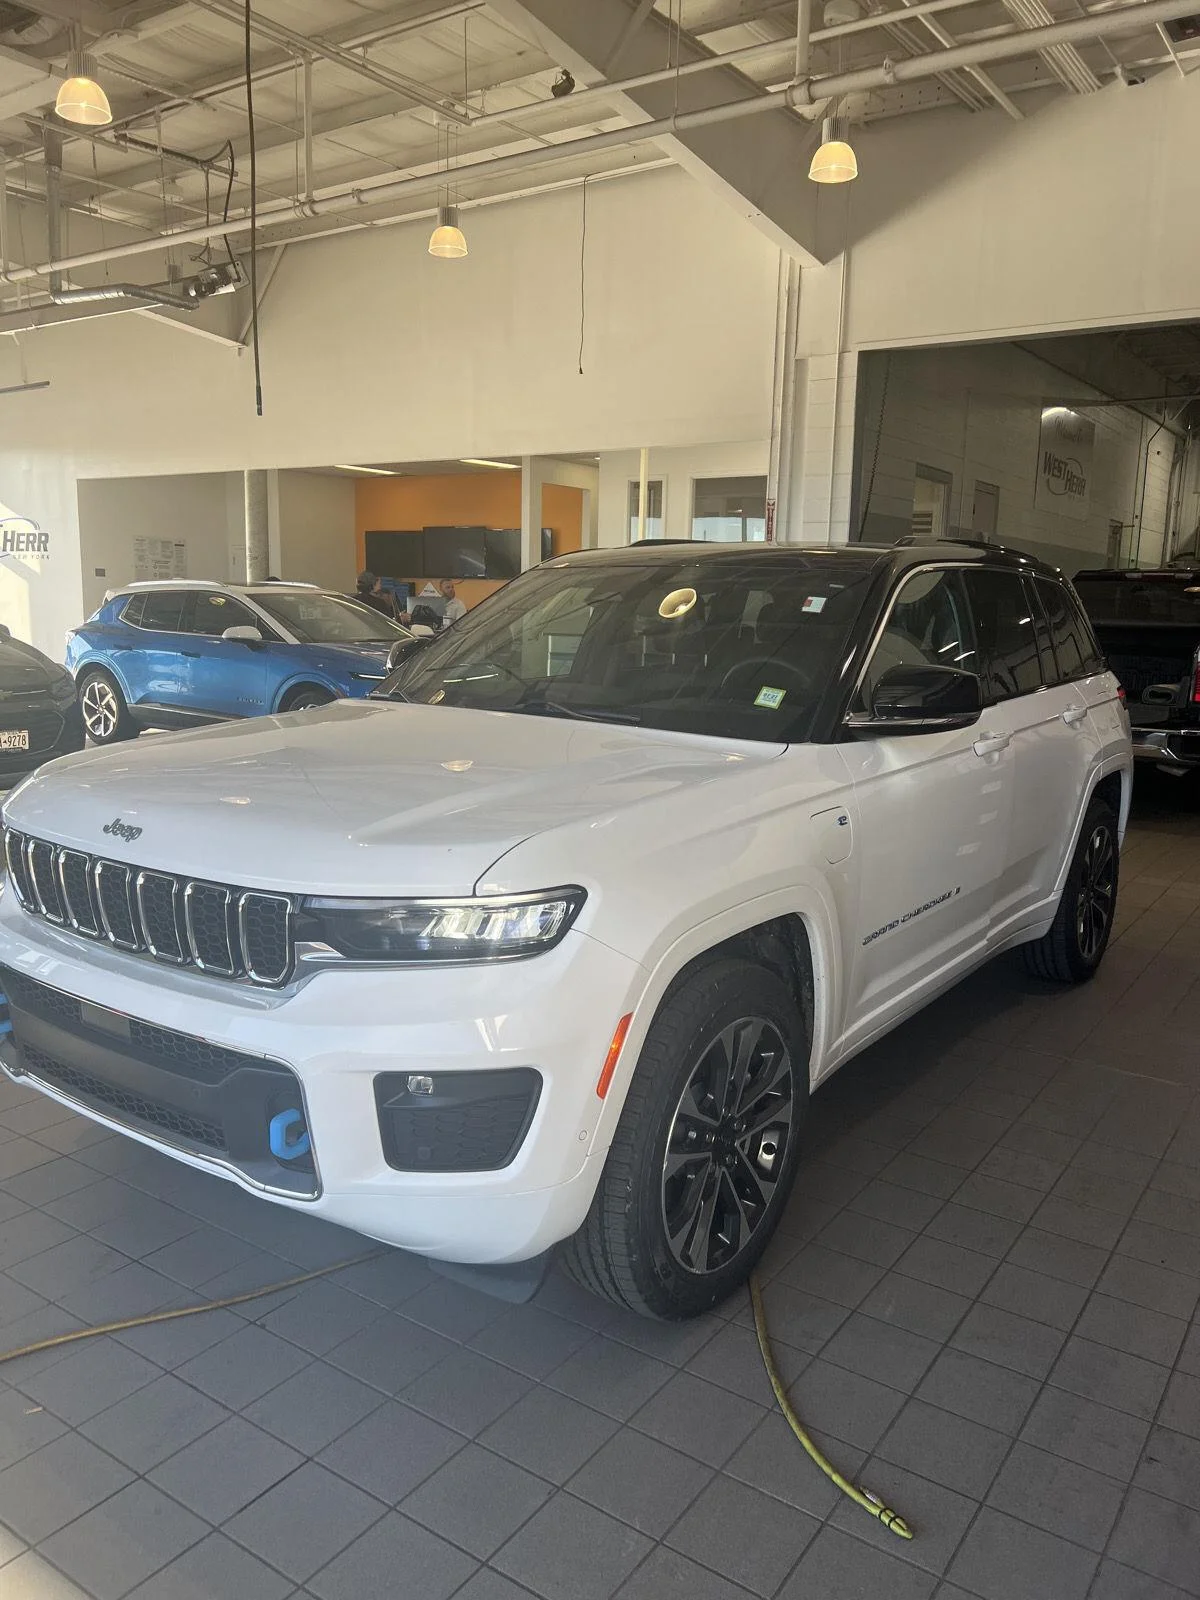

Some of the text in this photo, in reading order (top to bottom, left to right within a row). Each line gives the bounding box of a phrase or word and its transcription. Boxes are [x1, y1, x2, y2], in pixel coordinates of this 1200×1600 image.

[1043, 451, 1068, 480] WEST
[2, 530, 49, 552] HERR
[102, 818, 142, 842] Jeep
